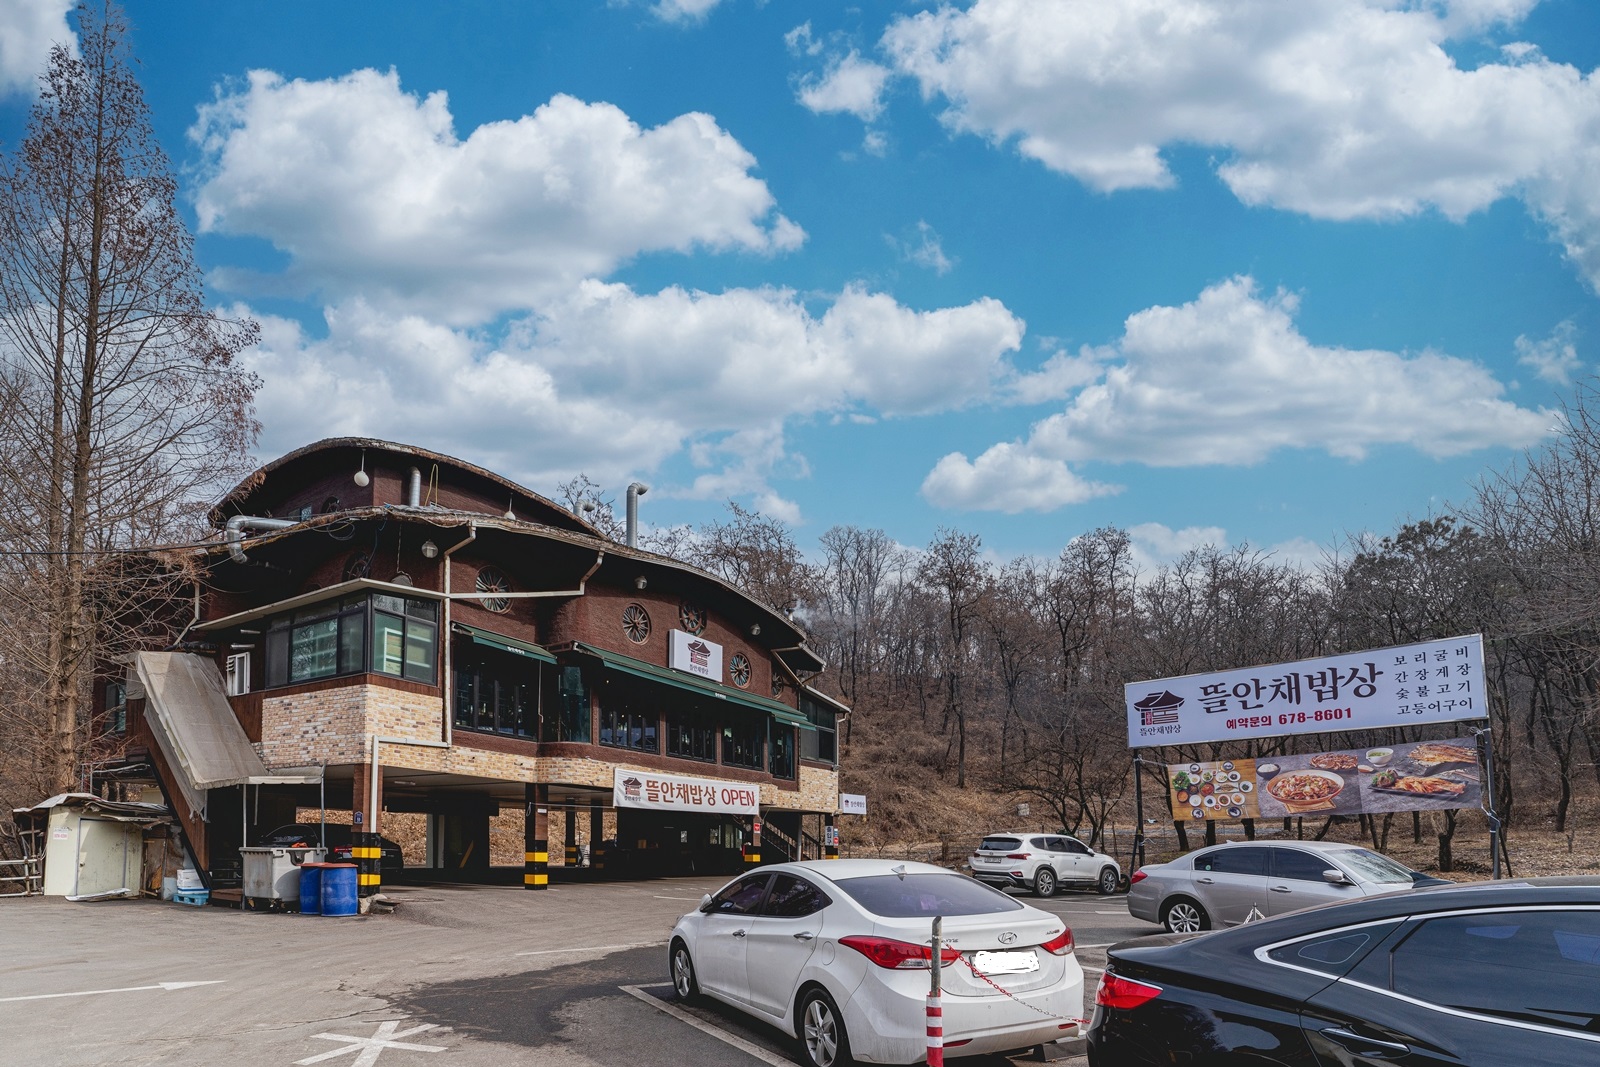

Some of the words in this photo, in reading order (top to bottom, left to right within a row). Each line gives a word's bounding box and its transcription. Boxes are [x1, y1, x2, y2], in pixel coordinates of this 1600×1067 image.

[1197, 662, 1384, 714] 뜰안채밥상
[1397, 697, 1473, 715] 고등어구이
[1226, 715, 1272, 729] 예약문의
[1278, 707, 1352, 725] 678-8601
[1139, 724, 1182, 737] 뜰안채밥상
[645, 779, 717, 806] 뜰안채밥상
[721, 788, 755, 807] OPEN
